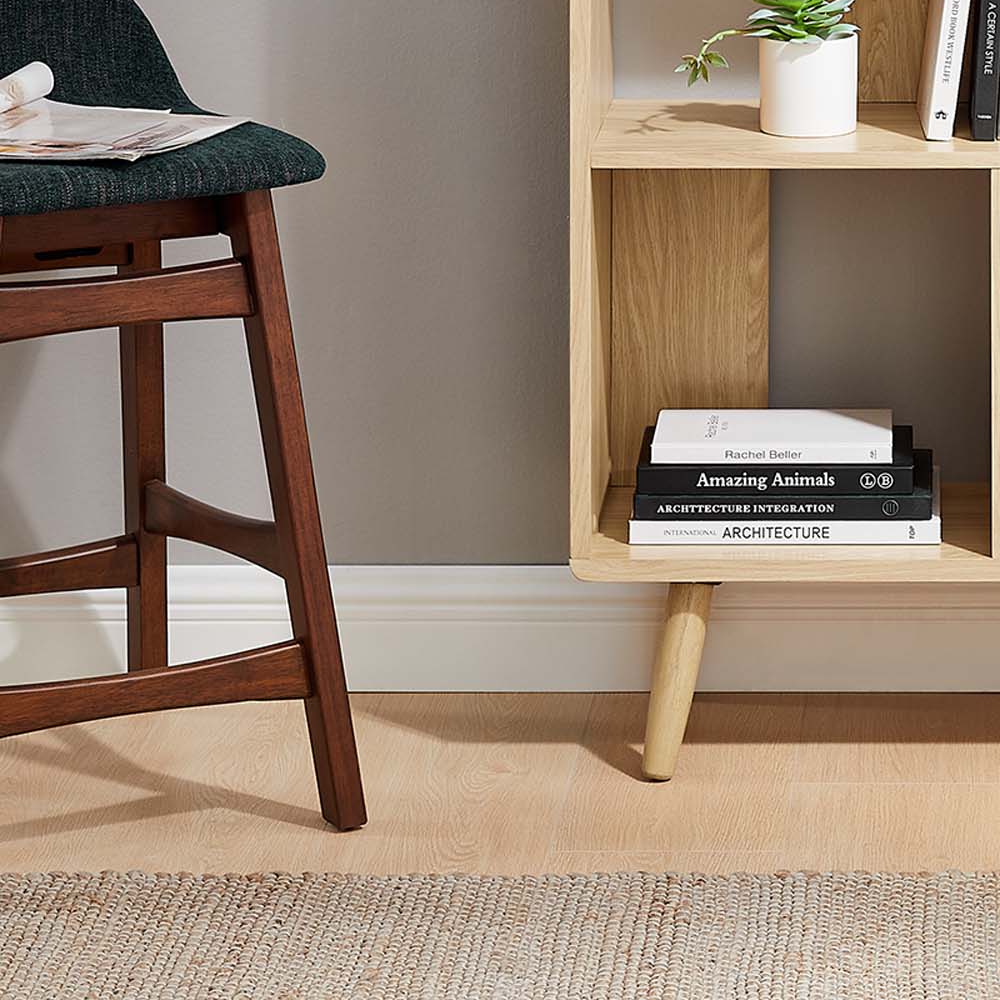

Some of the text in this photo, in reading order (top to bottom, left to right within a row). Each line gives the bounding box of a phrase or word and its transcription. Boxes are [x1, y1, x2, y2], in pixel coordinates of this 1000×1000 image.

[988, 2, 997, 10] A
[942, 41, 955, 83] WESTLIFE
[983, 50, 994, 75] STYLE
[724, 450, 802, 459] Rachel Beller
[696, 472, 836, 491] Amazing Animals
[753, 504, 835, 514] INTEGRATION
[663, 526, 830, 539] INTERNATIONAL ARCHITECTURE
